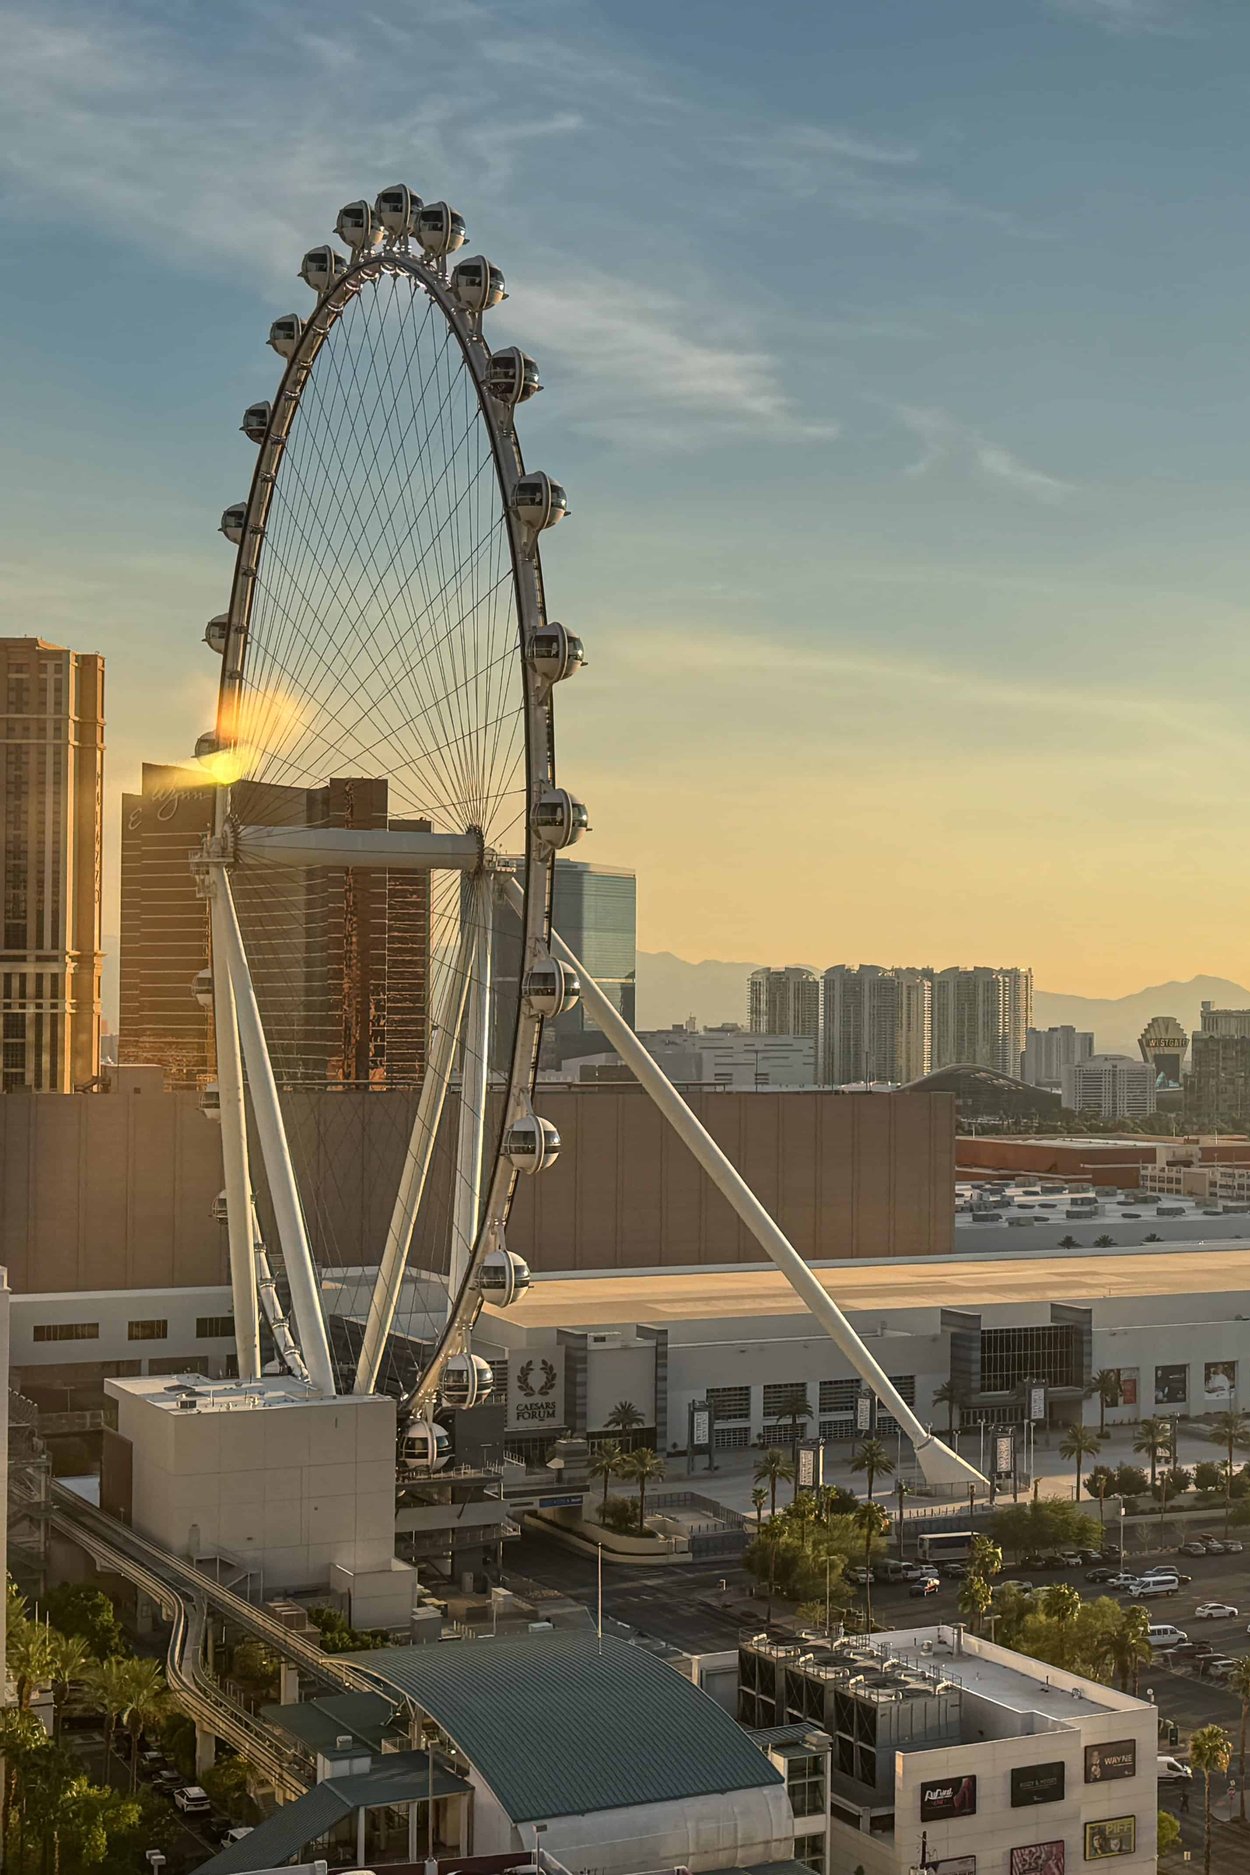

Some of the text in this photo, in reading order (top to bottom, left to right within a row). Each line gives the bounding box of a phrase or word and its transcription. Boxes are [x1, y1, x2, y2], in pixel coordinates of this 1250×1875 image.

[516, 1401, 556, 1411] CAESARS
[516, 1410, 556, 1421] FORUM
[1104, 1754, 1132, 1765] WAYNE
[1105, 1821, 1132, 1835] PIFF
